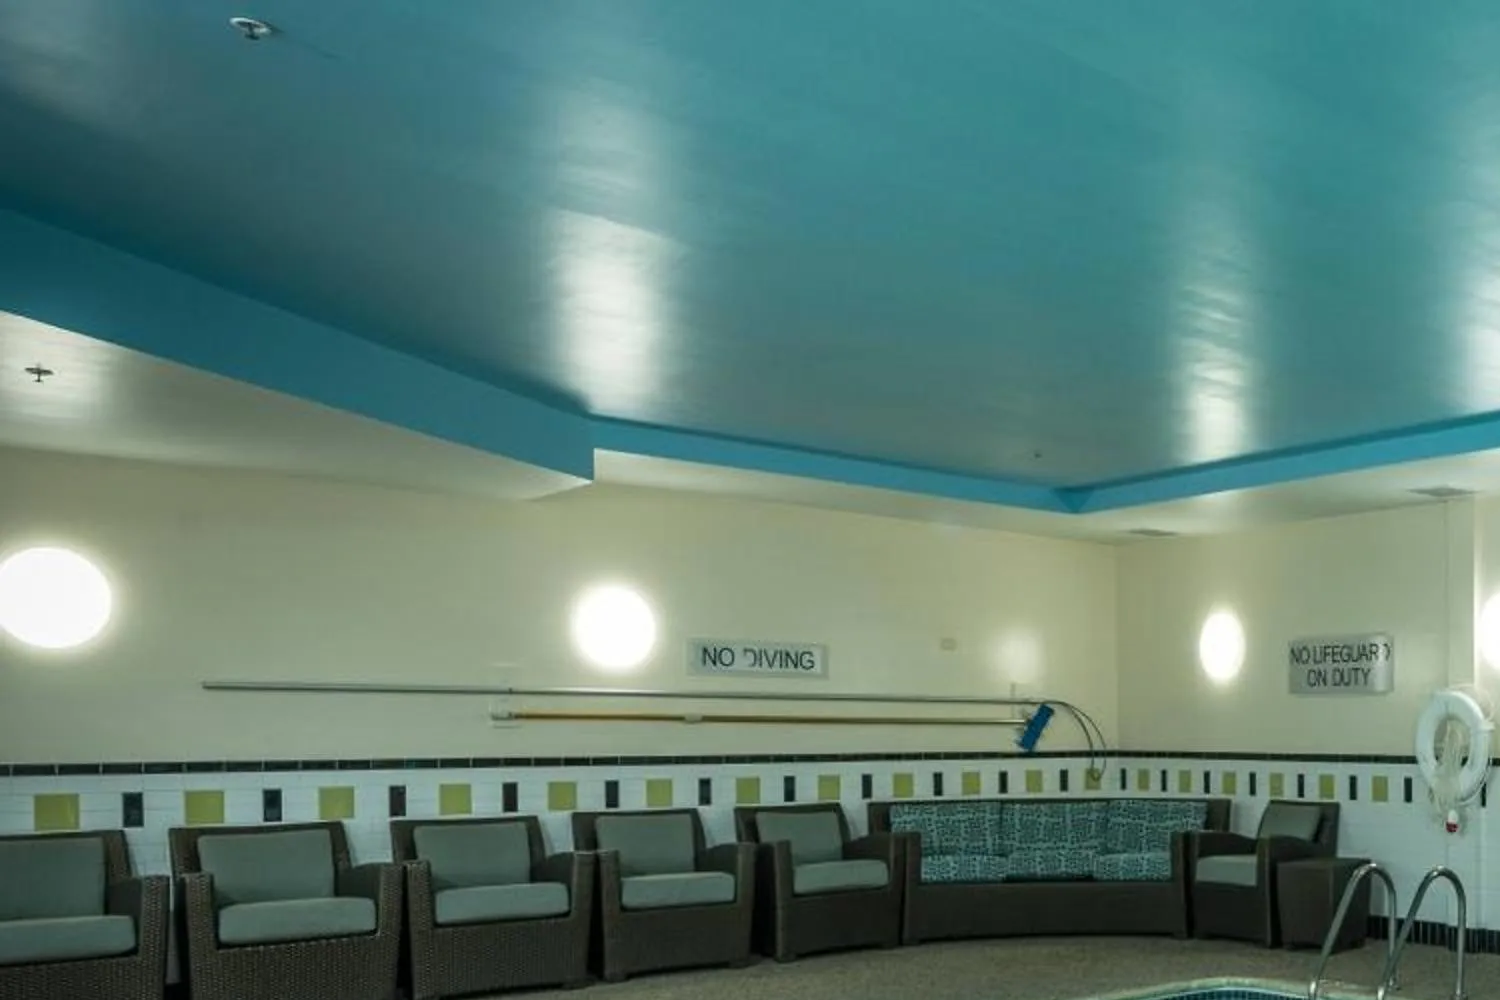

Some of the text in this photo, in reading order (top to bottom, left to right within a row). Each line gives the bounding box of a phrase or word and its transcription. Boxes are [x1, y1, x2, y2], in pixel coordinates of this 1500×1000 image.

[702, 647, 815, 671] NO DIVING
[1290, 646, 1310, 665] NO
[1306, 667, 1371, 687] ON DUTY
